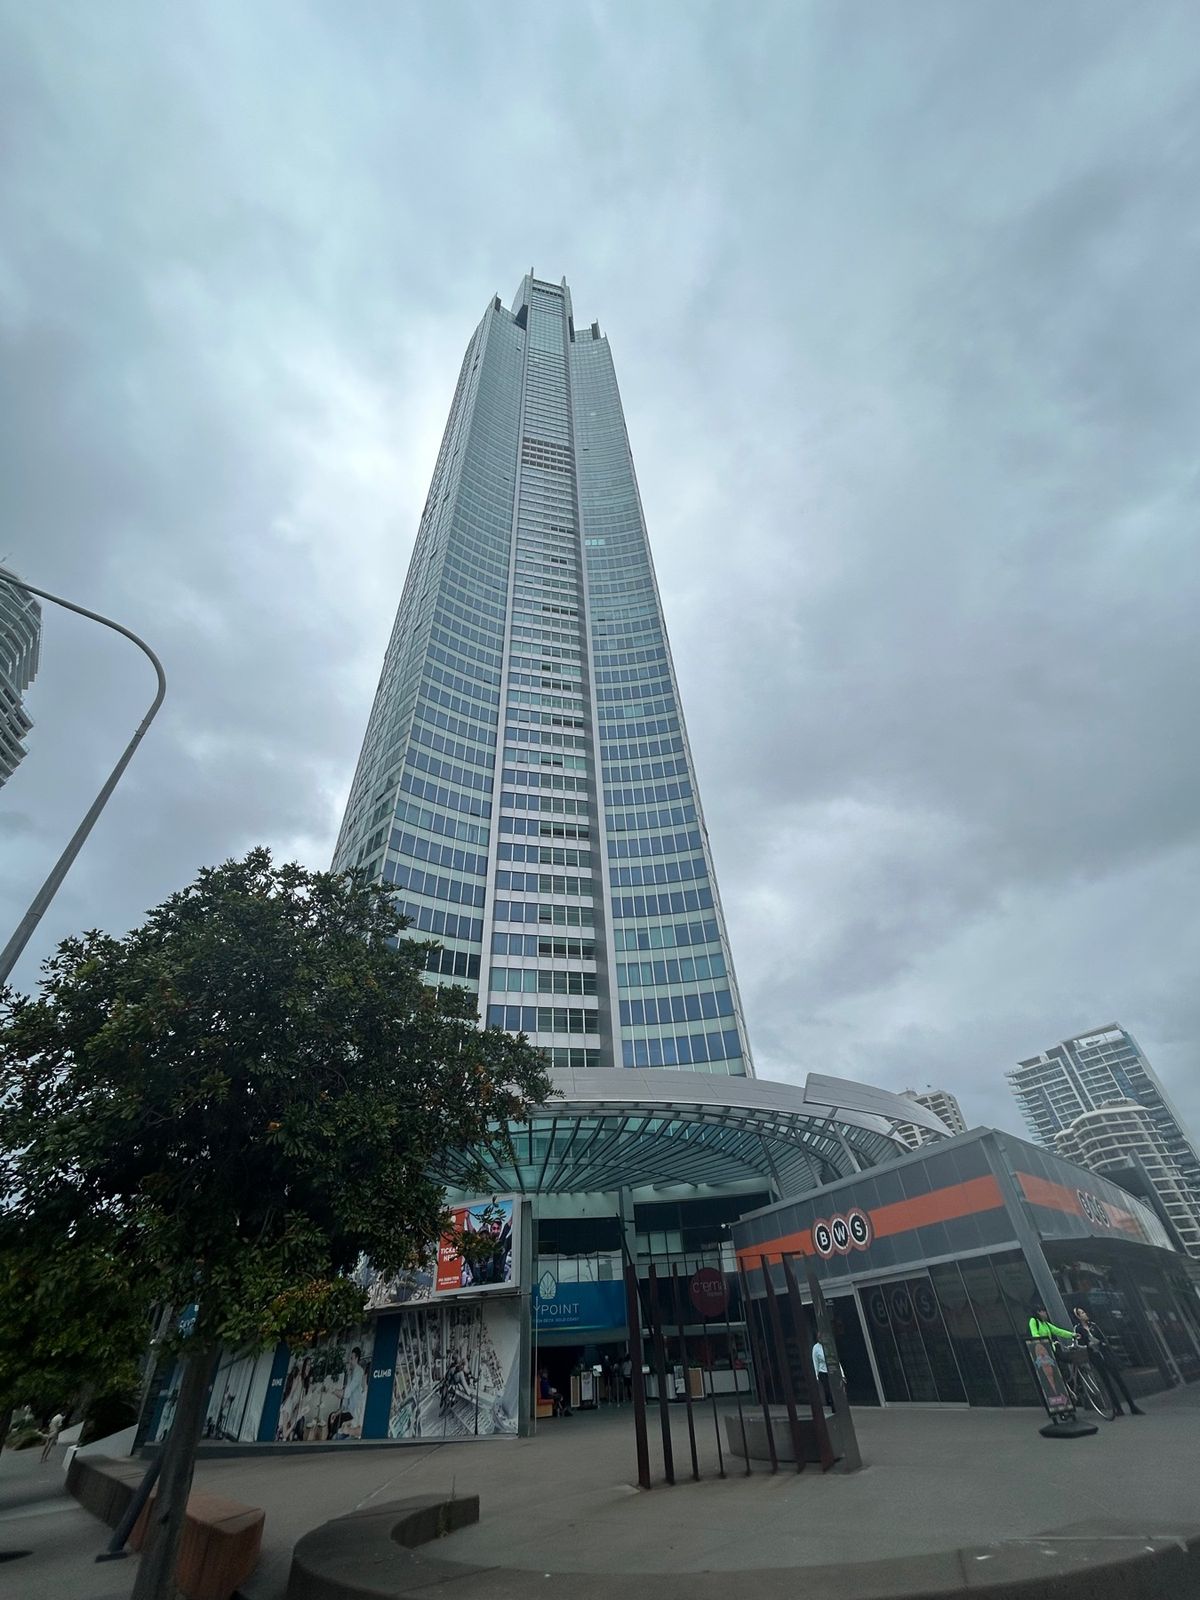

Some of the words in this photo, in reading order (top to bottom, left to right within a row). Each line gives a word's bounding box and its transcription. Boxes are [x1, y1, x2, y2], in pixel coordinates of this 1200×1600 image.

[818, 1220, 864, 1247] BWS
[532, 1302, 580, 1316] YPOINT
[875, 1294, 931, 1319] BWS
[373, 1368, 392, 1379] CLIMB
